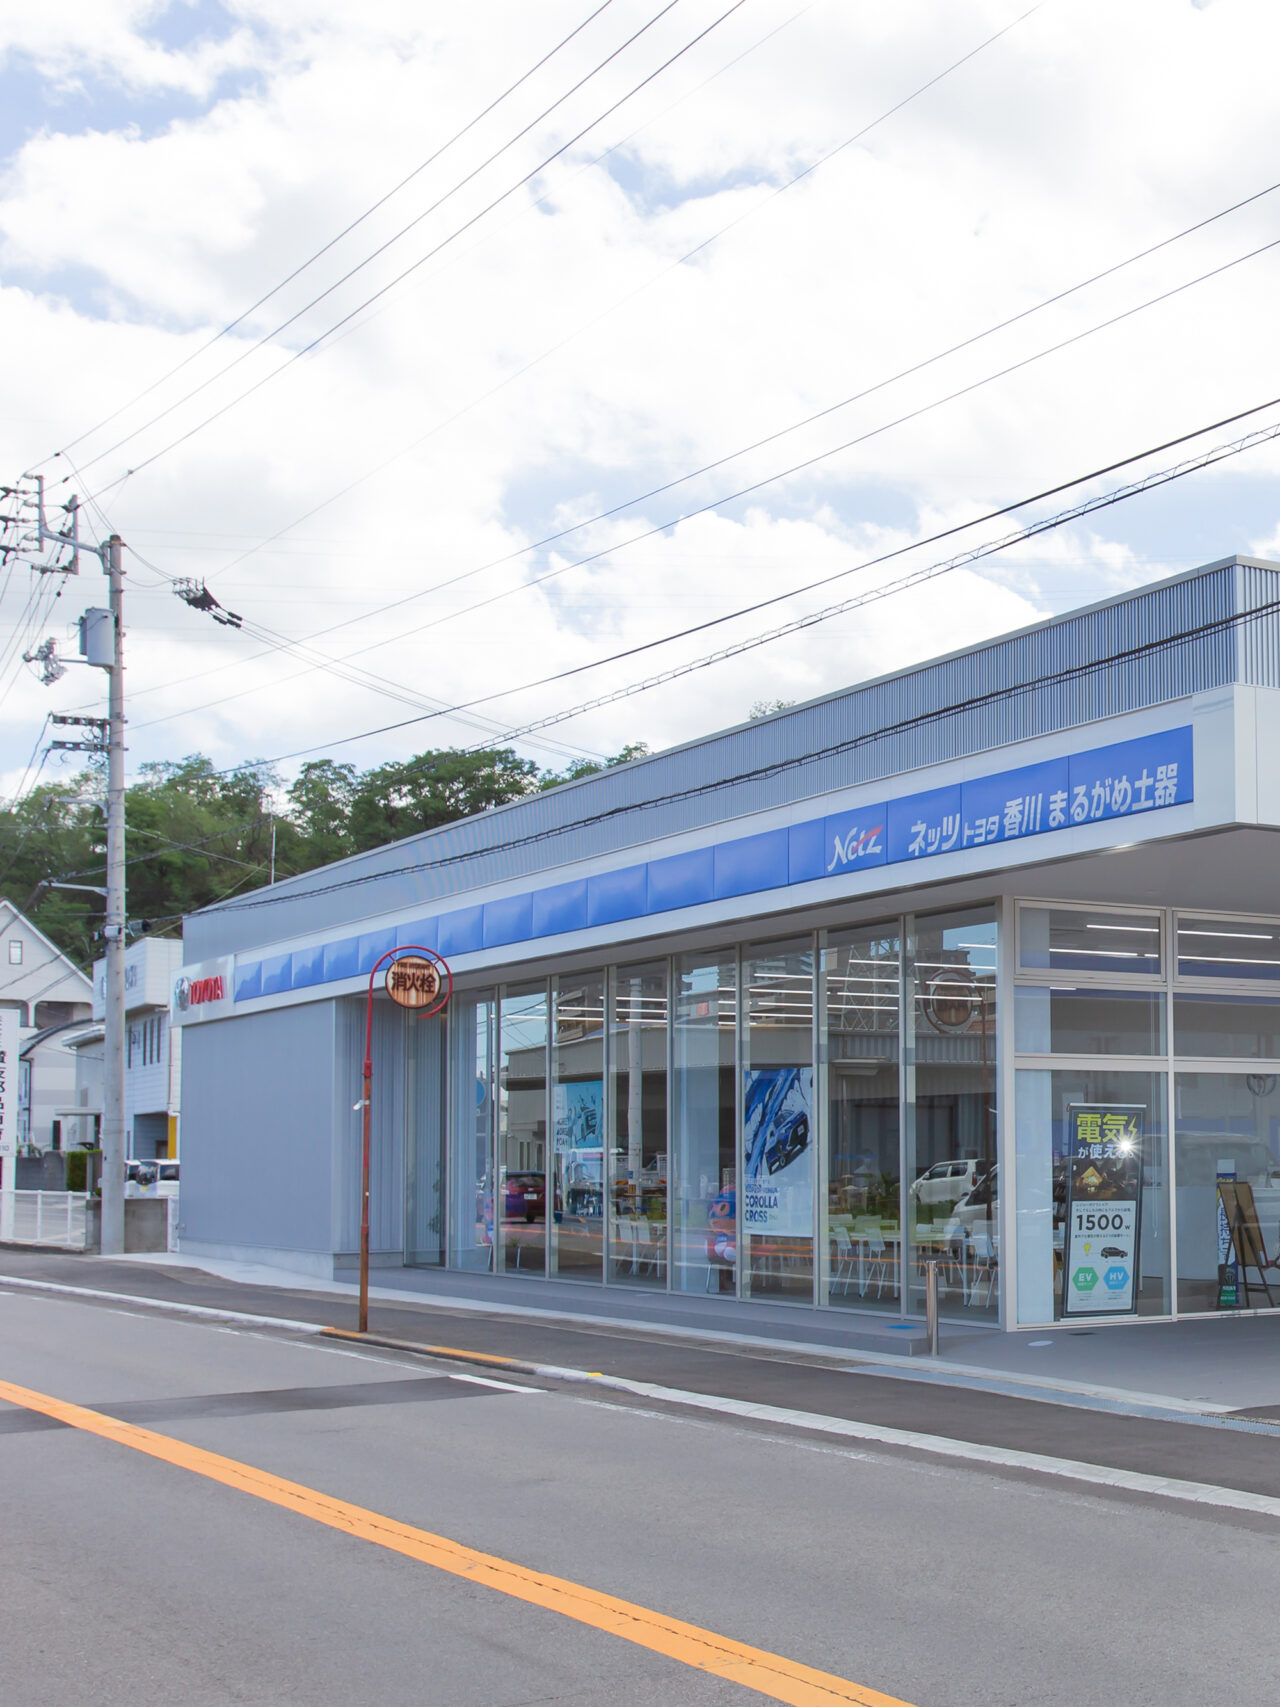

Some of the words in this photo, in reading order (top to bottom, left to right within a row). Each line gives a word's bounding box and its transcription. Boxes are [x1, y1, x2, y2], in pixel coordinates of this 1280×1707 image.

[1049, 763, 1178, 828] まるがめ土器
[827, 826, 883, 871] Netz
[391, 971, 436, 993] 消火栓
[1077, 1113, 1128, 1143] 電気
[745, 1195, 778, 1208] COROLLA
[745, 1209, 768, 1223] CROSS
[1078, 1272, 1093, 1282] EV
[1109, 1271, 1124, 1281] HV
